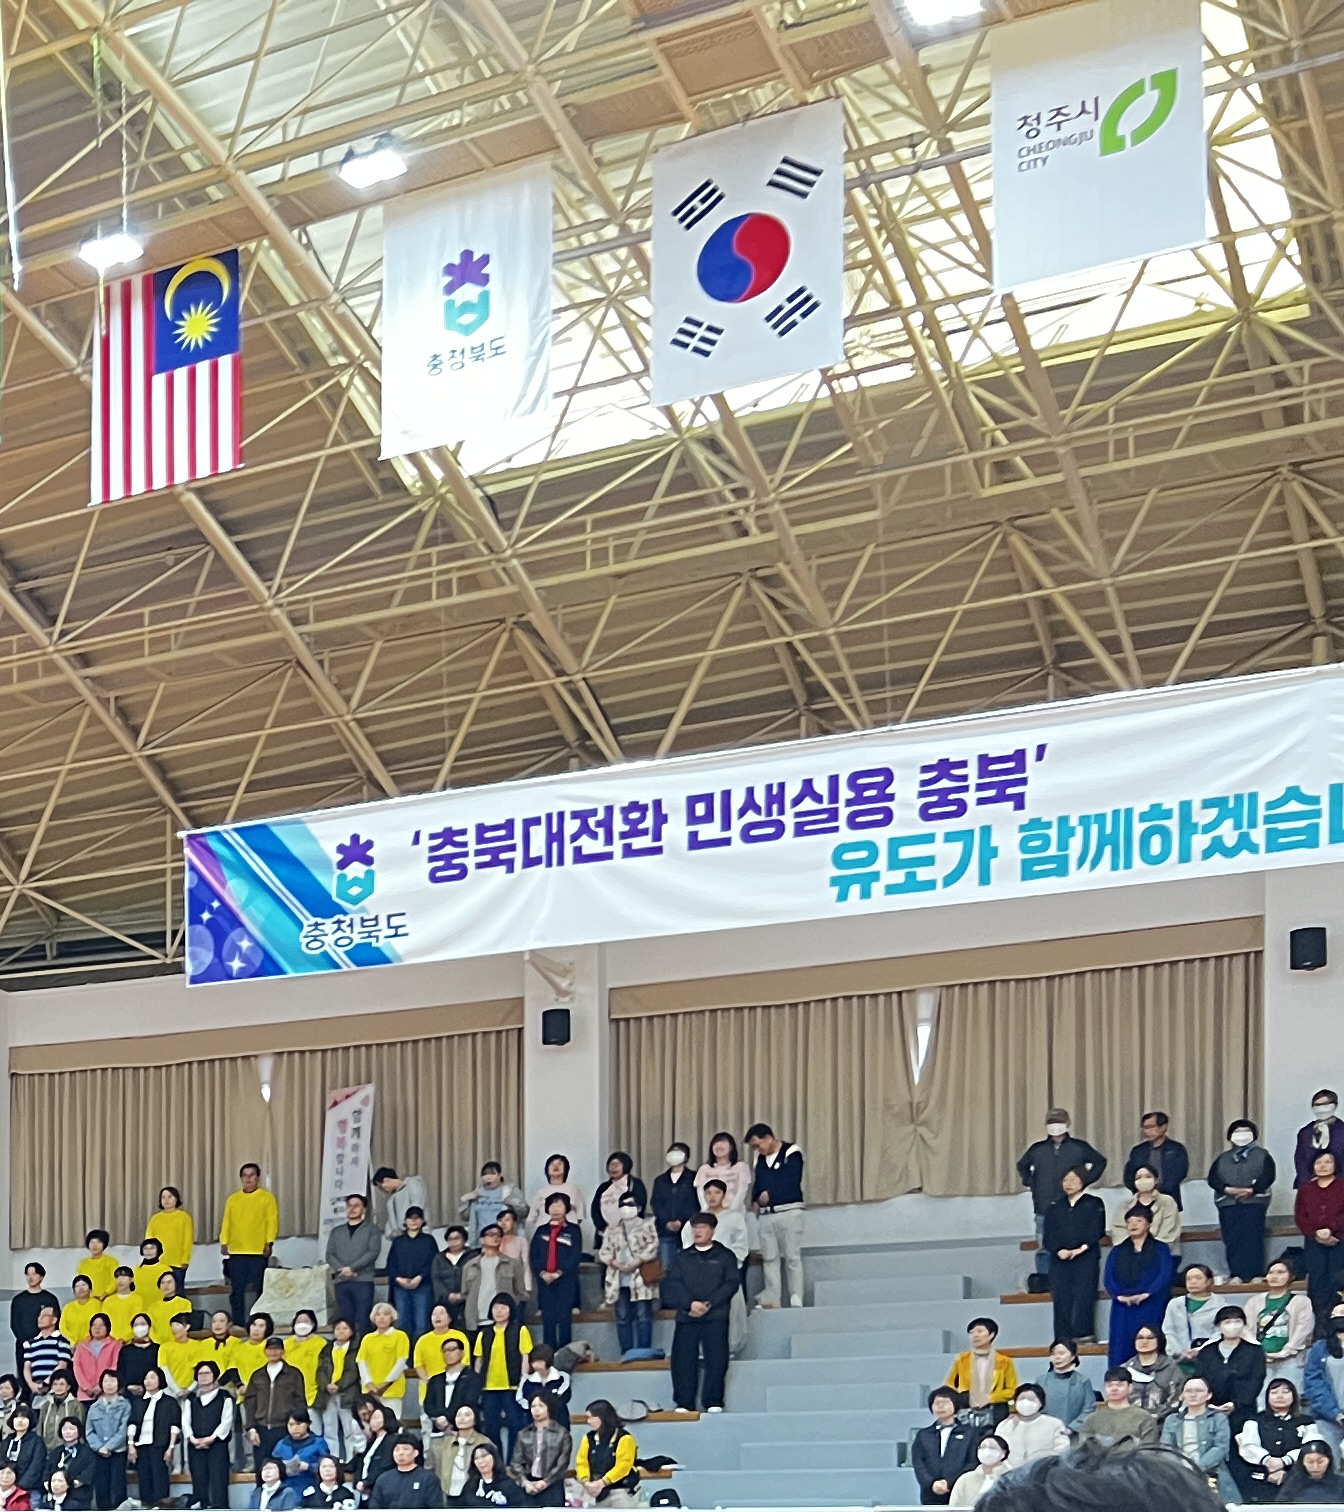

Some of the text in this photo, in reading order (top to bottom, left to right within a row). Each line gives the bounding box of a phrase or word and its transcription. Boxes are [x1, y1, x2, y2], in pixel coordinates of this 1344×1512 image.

[1017, 96, 1100, 139] 청주시
[1017, 129, 1094, 159] CHEONGJU
[1017, 155, 1050, 172] CITY
[427, 335, 507, 376] 충청북도
[685, 766, 896, 852] 민생실용
[829, 824, 999, 902] 유도가
[303, 912, 409, 950] 충청북도
